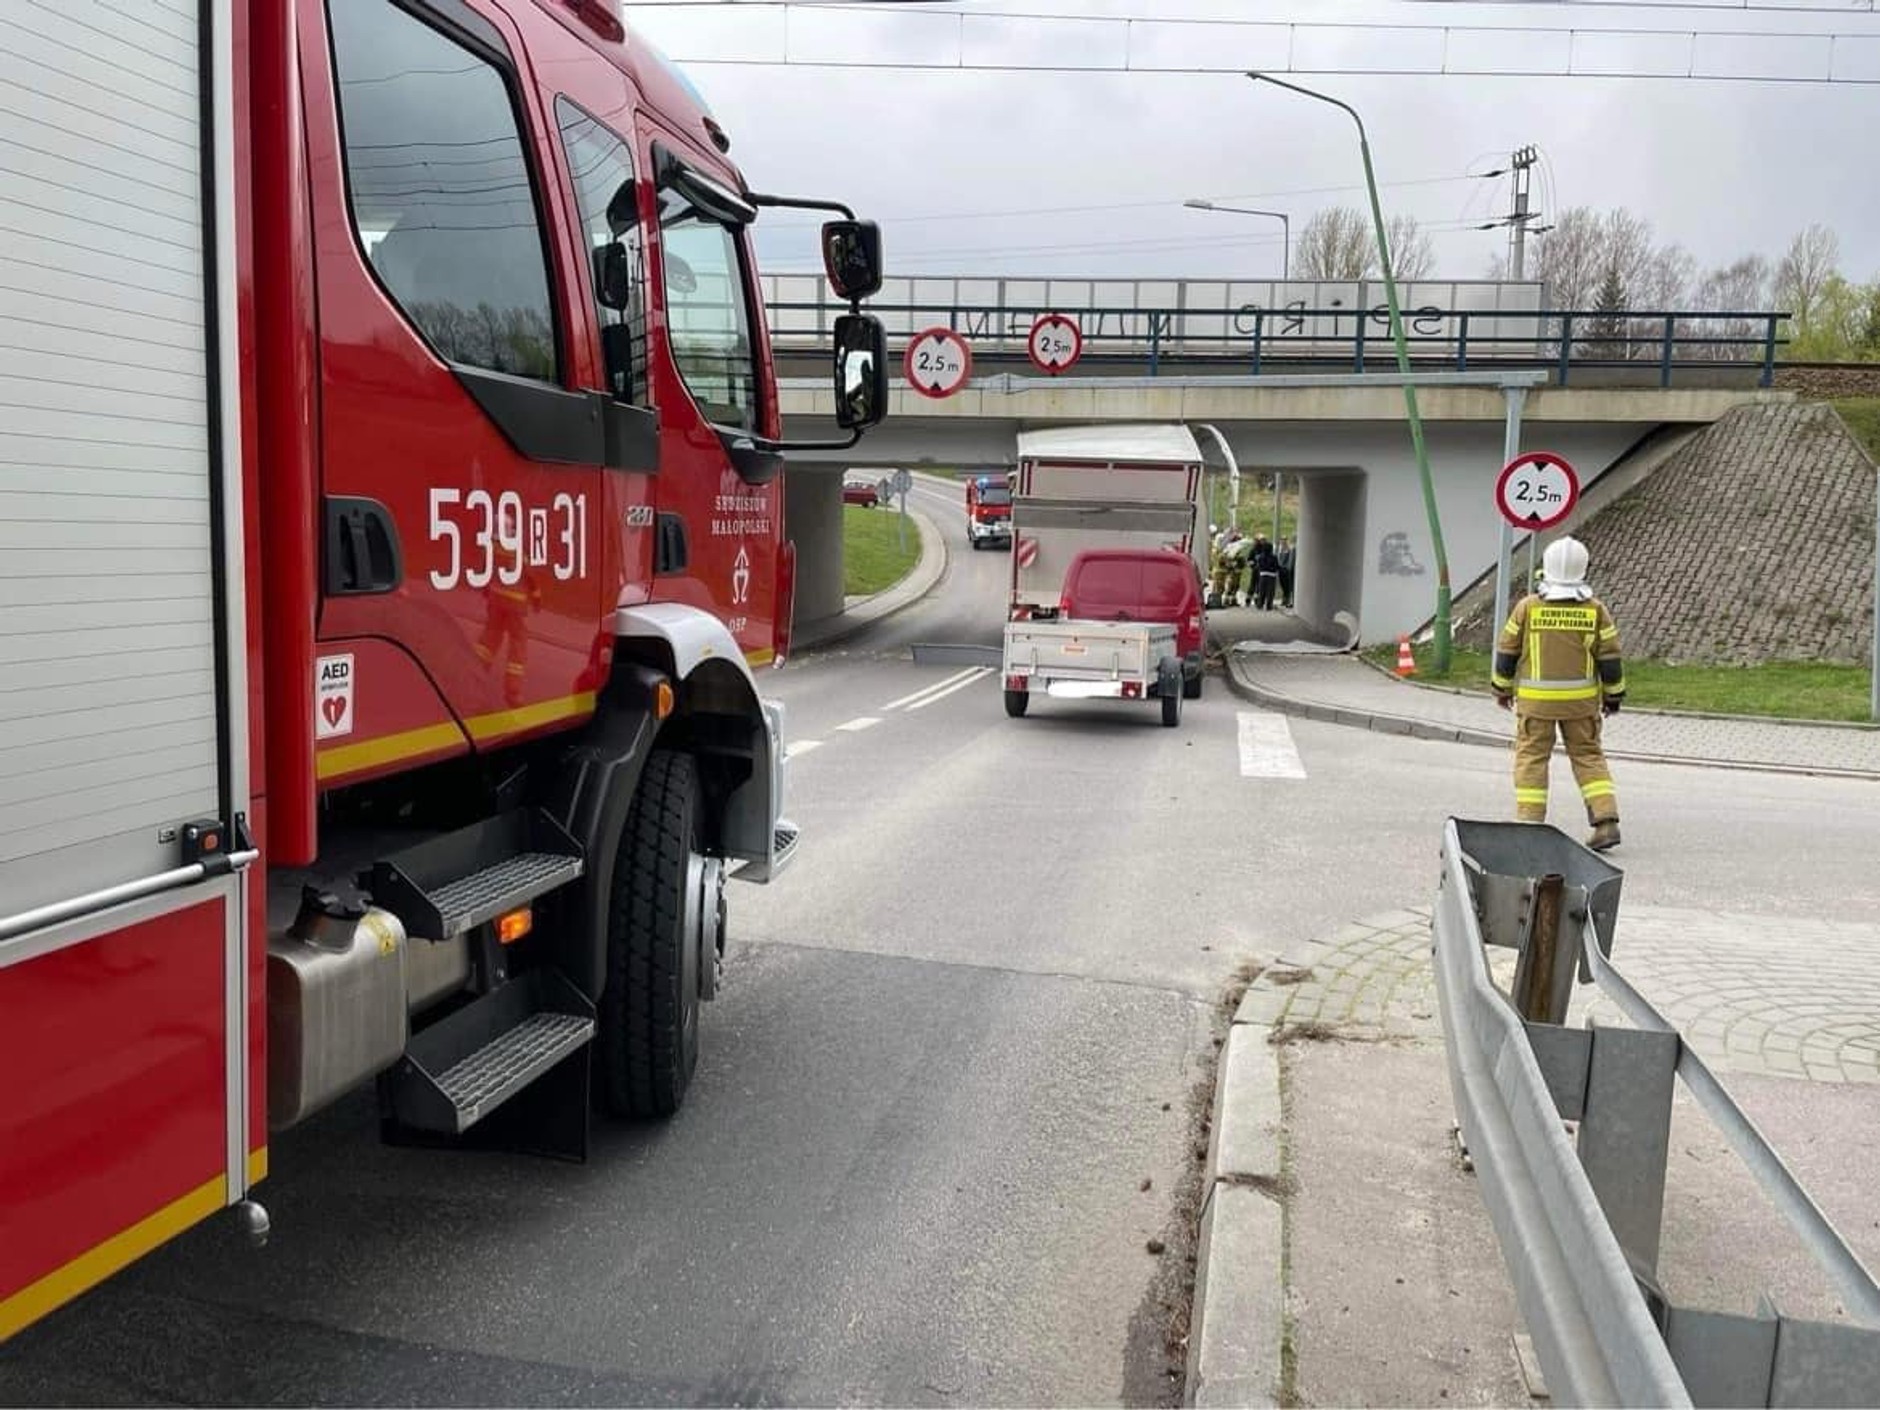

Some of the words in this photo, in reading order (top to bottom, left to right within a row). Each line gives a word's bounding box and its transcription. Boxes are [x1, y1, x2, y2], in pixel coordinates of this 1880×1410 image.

[711, 519, 770, 535] MAŁOPOLSKI
[430, 488, 523, 591] 539
[531, 509, 547, 566] R
[553, 492, 586, 581] 31
[321, 661, 349, 681] AED
